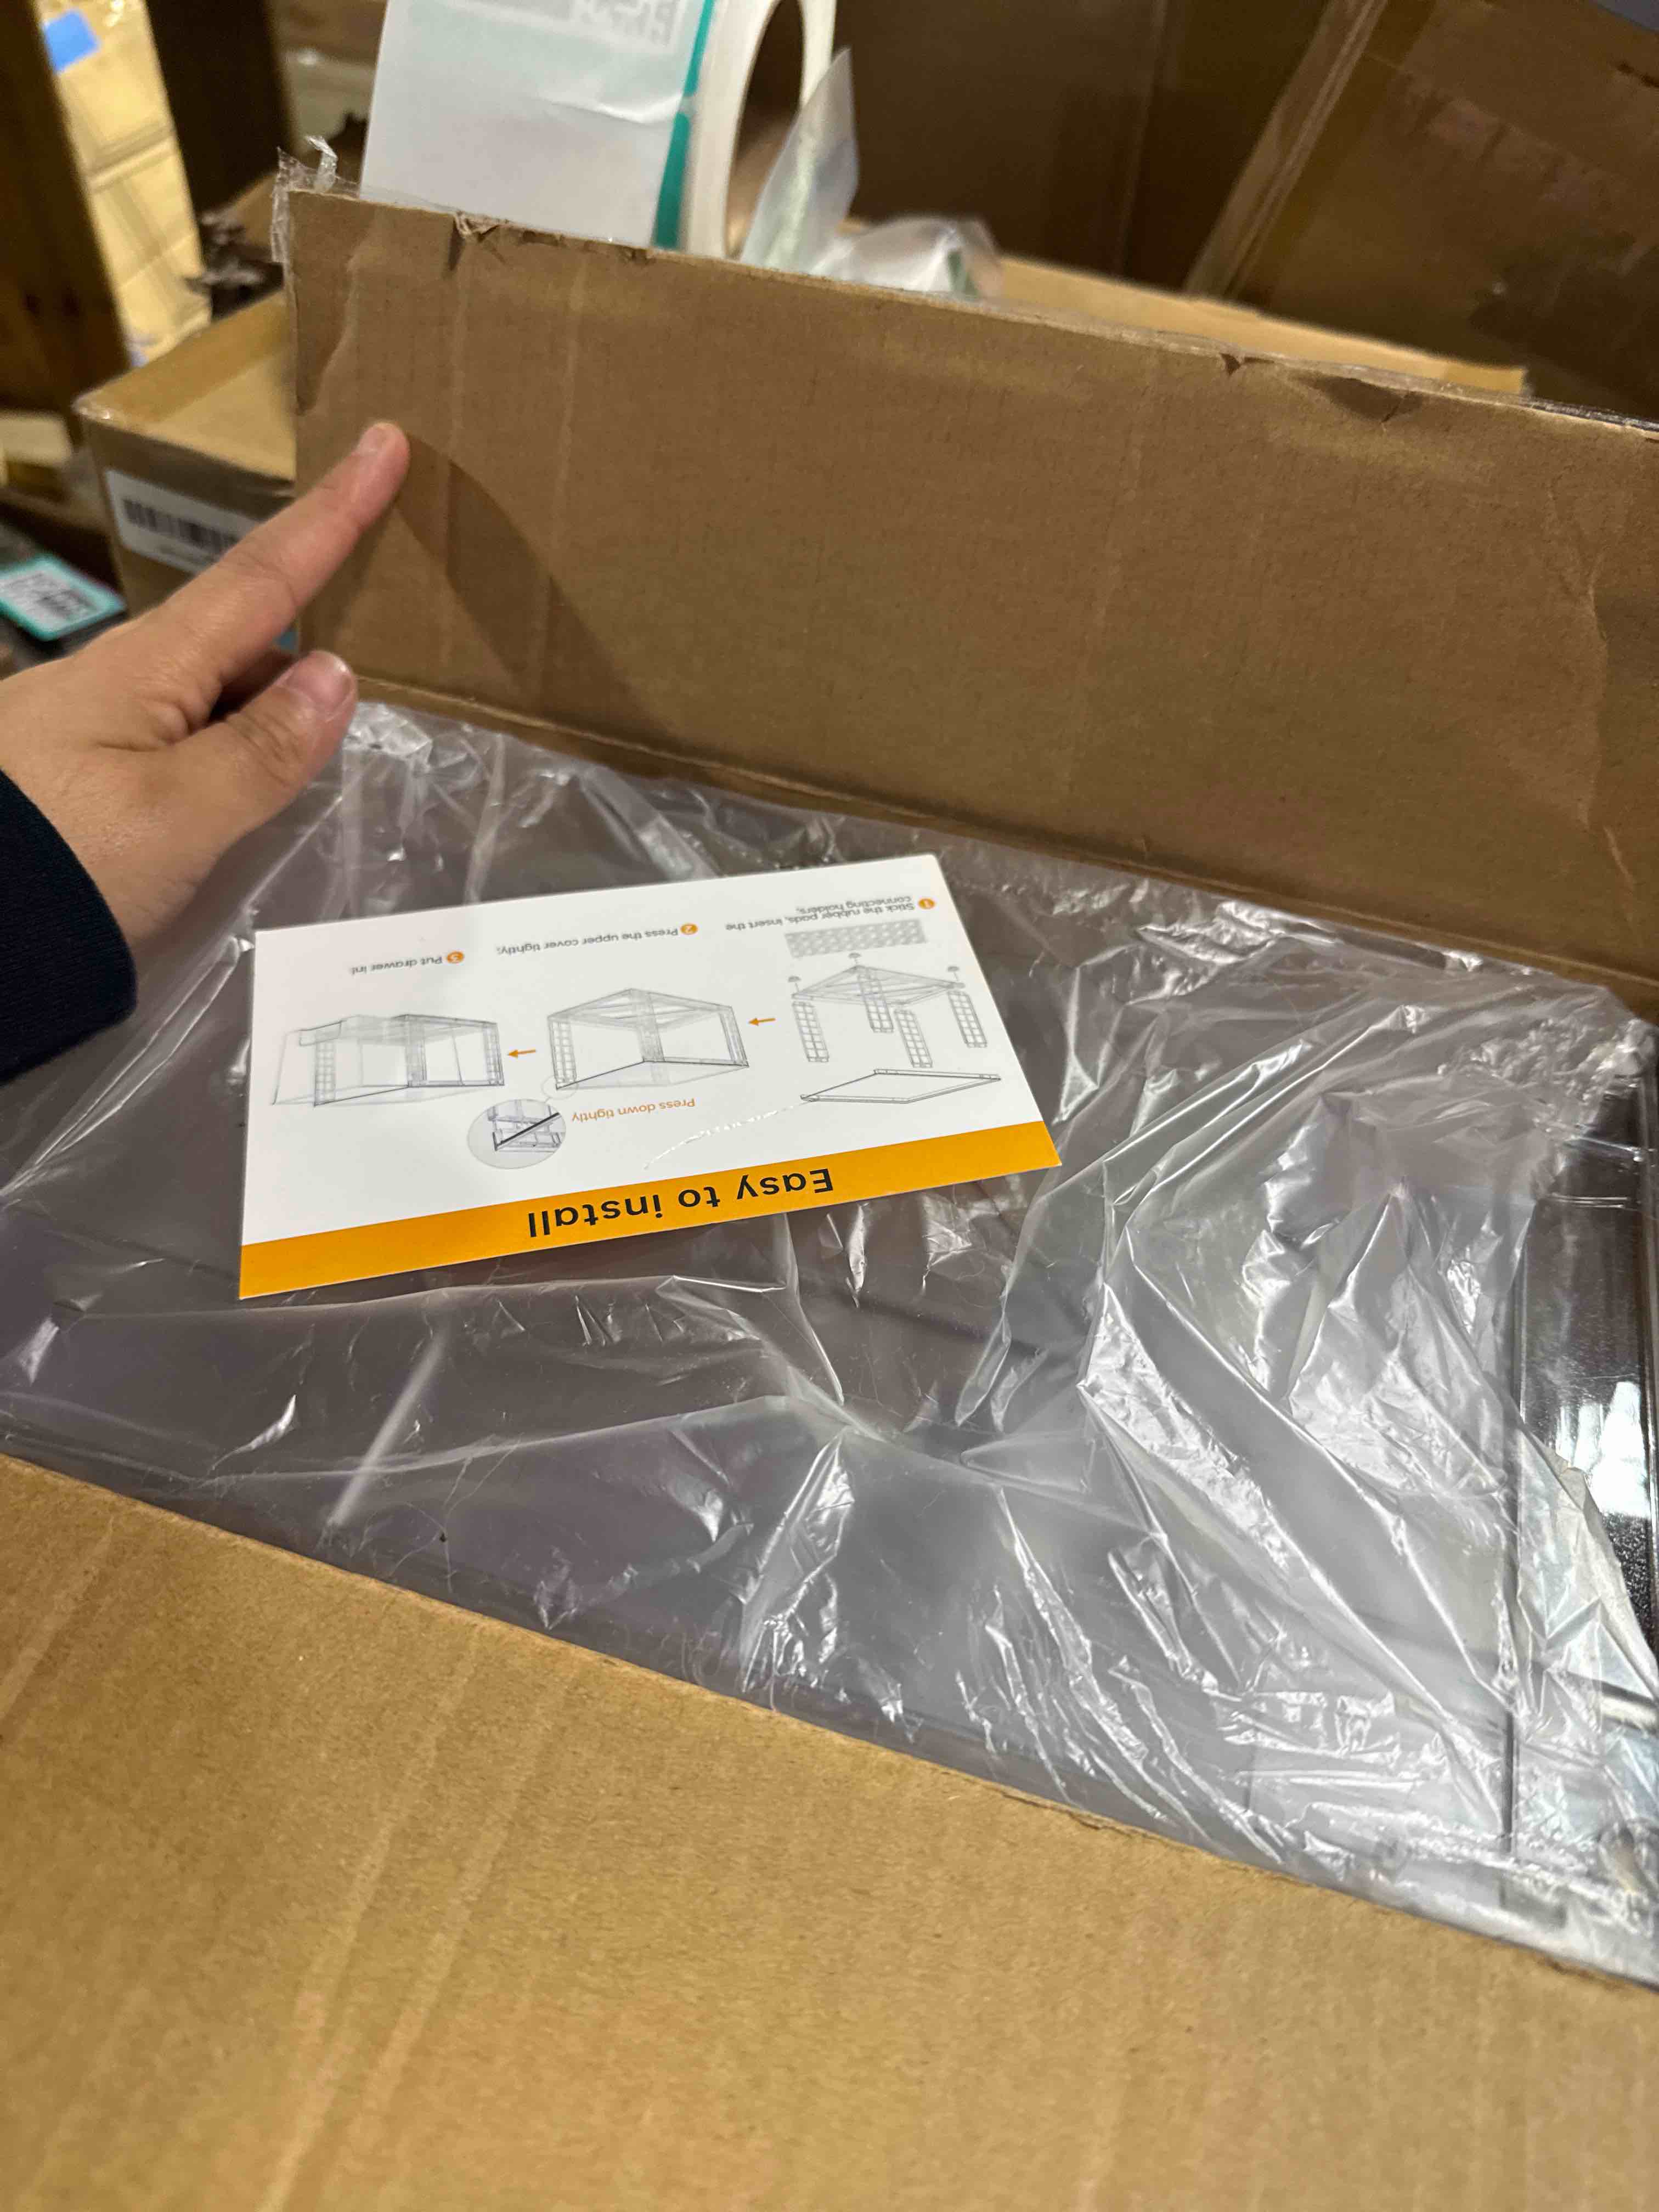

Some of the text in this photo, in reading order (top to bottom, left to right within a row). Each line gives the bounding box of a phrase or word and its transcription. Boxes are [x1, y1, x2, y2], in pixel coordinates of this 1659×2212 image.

[846, 896, 911, 908] connecting
[885, 903, 915, 912] Stick
[785, 913, 818, 924] pads,
[821, 910, 861, 918] rubber
[748, 919, 783, 928] insert
[645, 928, 678, 938] Press
[582, 935, 619, 944] upper
[544, 940, 579, 949] cover
[371, 960, 417, 971] drawer
[420, 957, 442, 966] Put
[572, 1097, 695, 1123] Press down tightly
[528, 1168, 834, 1238] Easy to install
